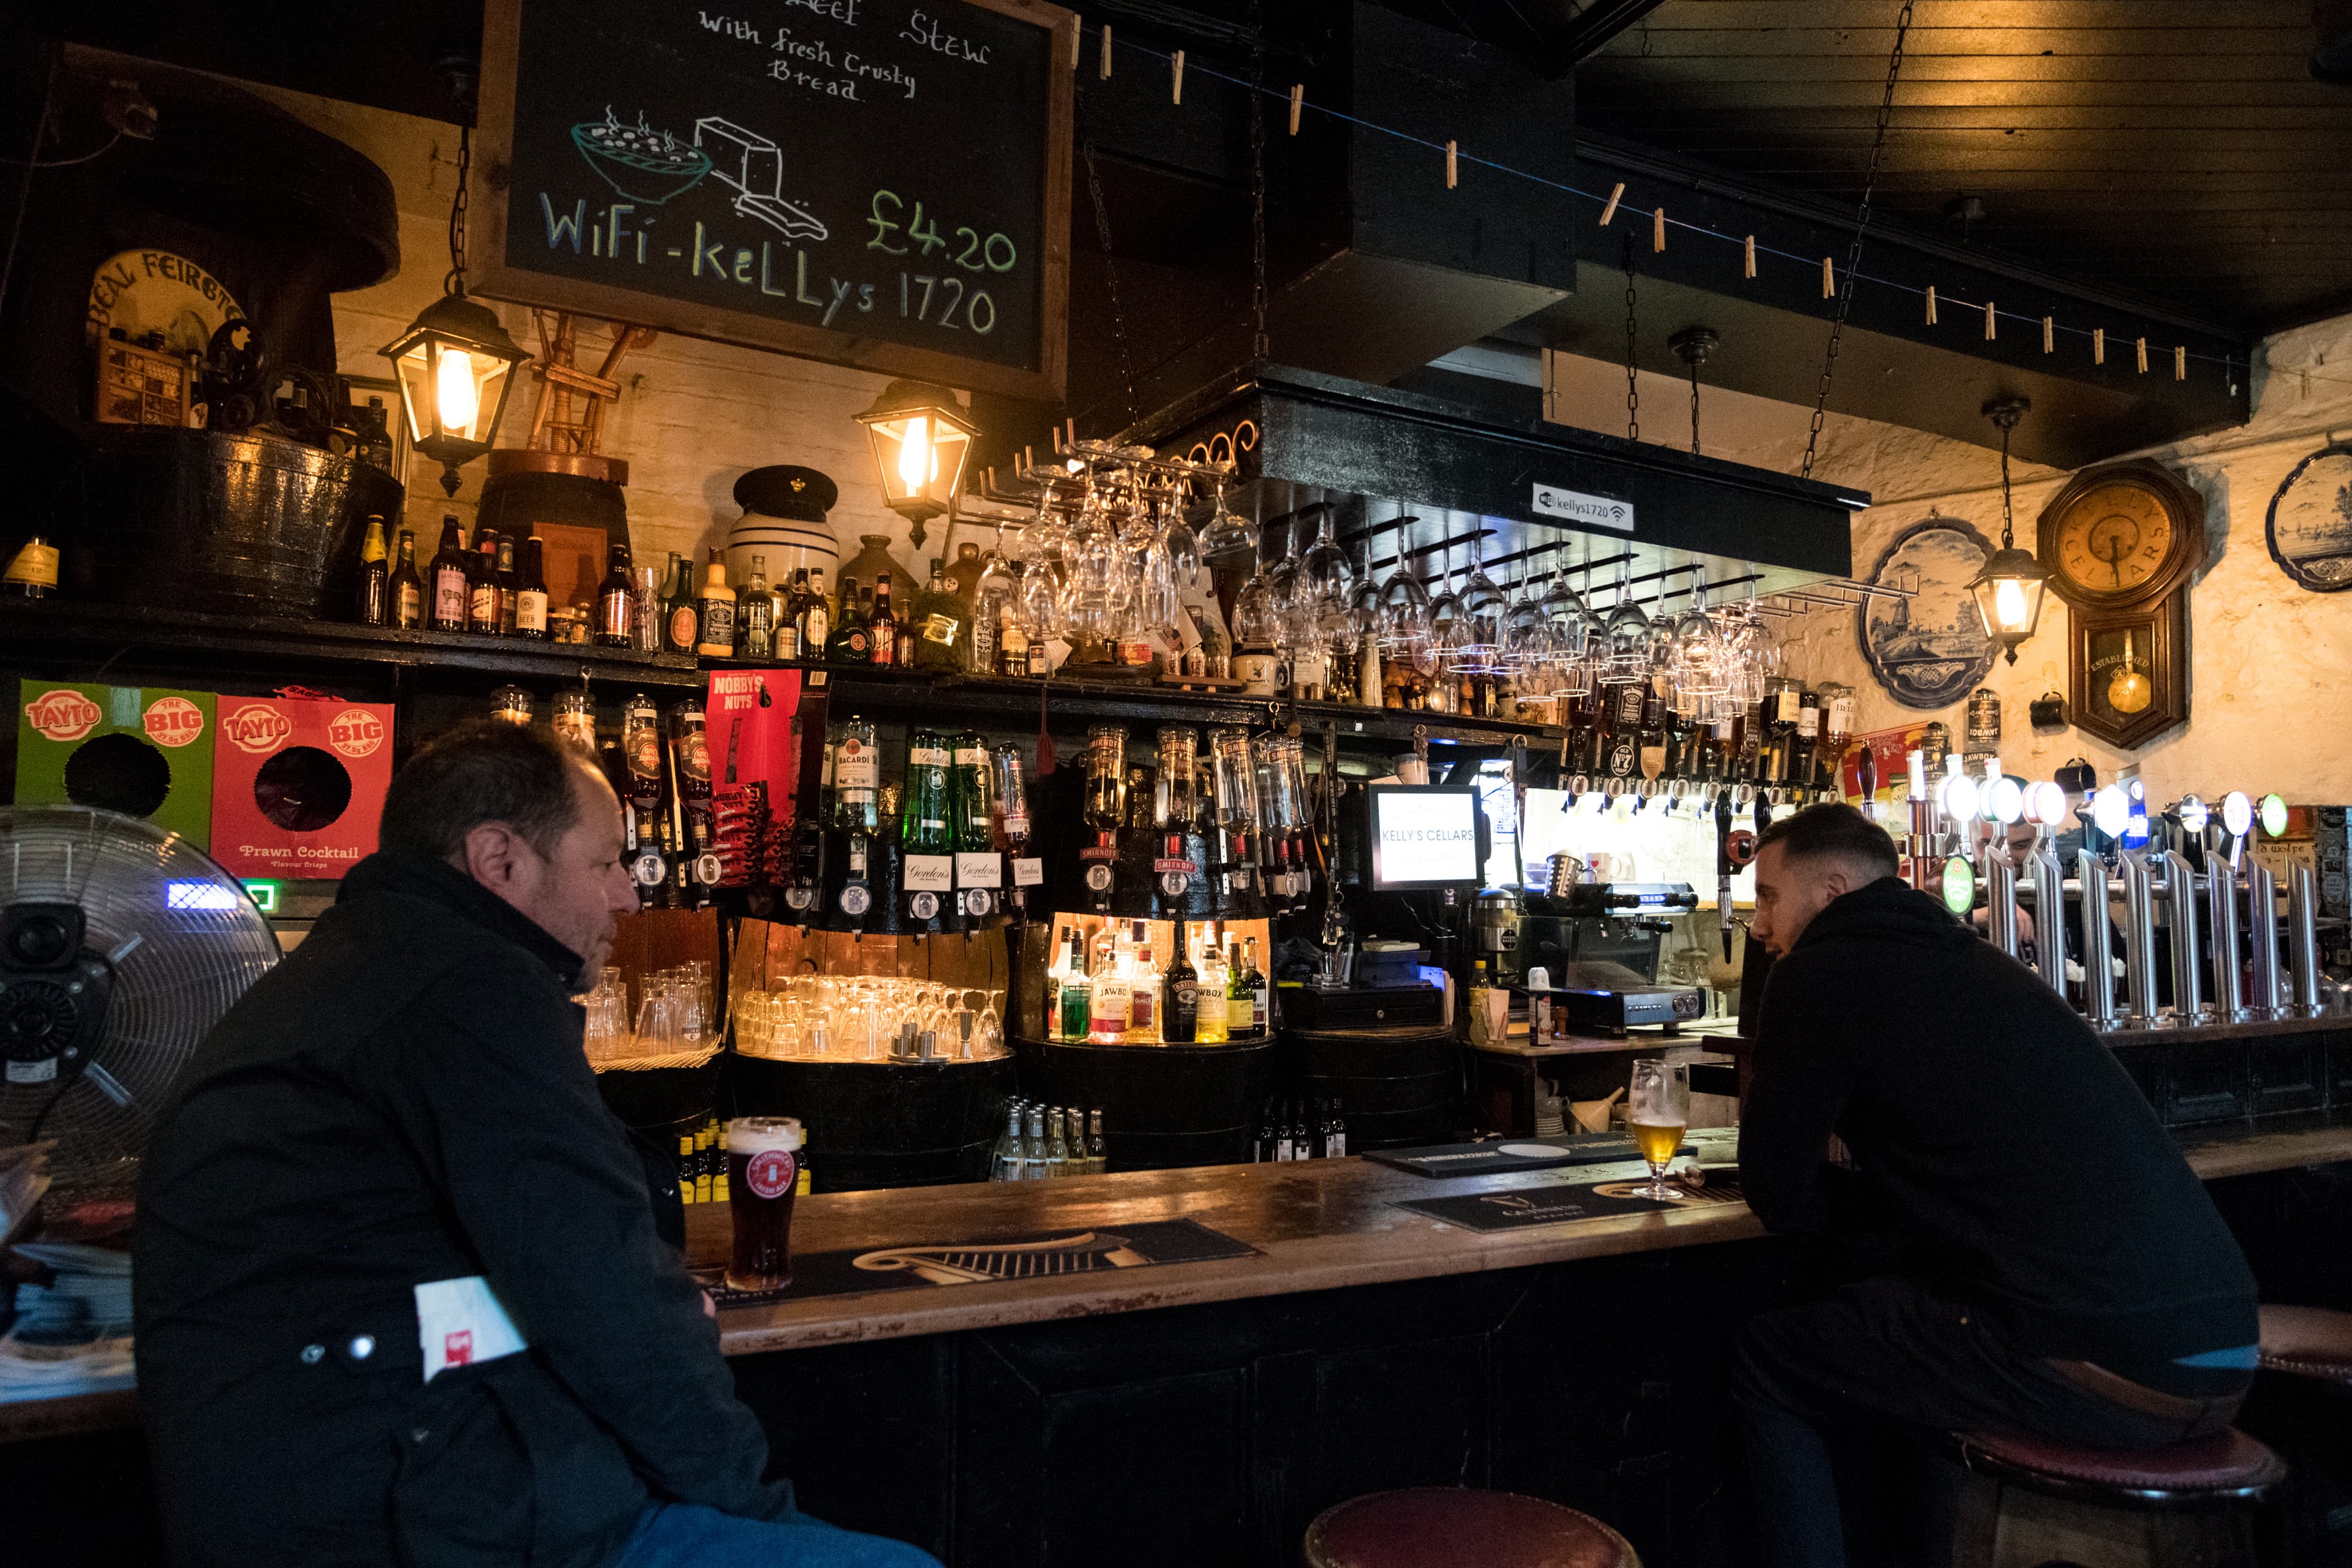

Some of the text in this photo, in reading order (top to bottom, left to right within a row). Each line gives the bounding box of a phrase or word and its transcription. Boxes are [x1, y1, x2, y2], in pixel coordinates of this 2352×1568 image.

[867, 190, 1016, 271] £4.20
[901, 273, 995, 333] 1720
[1558, 497, 1608, 518] kellys1720
[714, 674, 764, 694] NOBBY'S
[160, 700, 181, 709] THE
[725, 695, 753, 709] NUTS
[29, 703, 100, 729] TAYTO
[145, 710, 203, 733] BIG
[225, 714, 290, 741] TAYTO
[330, 722, 383, 744] BIG
[1969, 728, 1998, 736] JAWBOX
[839, 754, 870, 764] BACARDÍ
[1924, 763, 1939, 772] JAW
[1382, 830, 1474, 841] KELLY'S CELLARS
[239, 845, 359, 859] Prawn Cocktail
[1082, 848, 1117, 858] SMIRNOFF
[270, 861, 328, 869] Flavour Crisps
[907, 864, 950, 878] Gordon's
[960, 862, 1000, 876] Gordon's
[1157, 859, 1194, 870] SMIRNOFF
[1099, 987, 1128, 997] JAWBO
[1199, 989, 1223, 998] WBOX
[755, 1181, 775, 1194] IRISH
